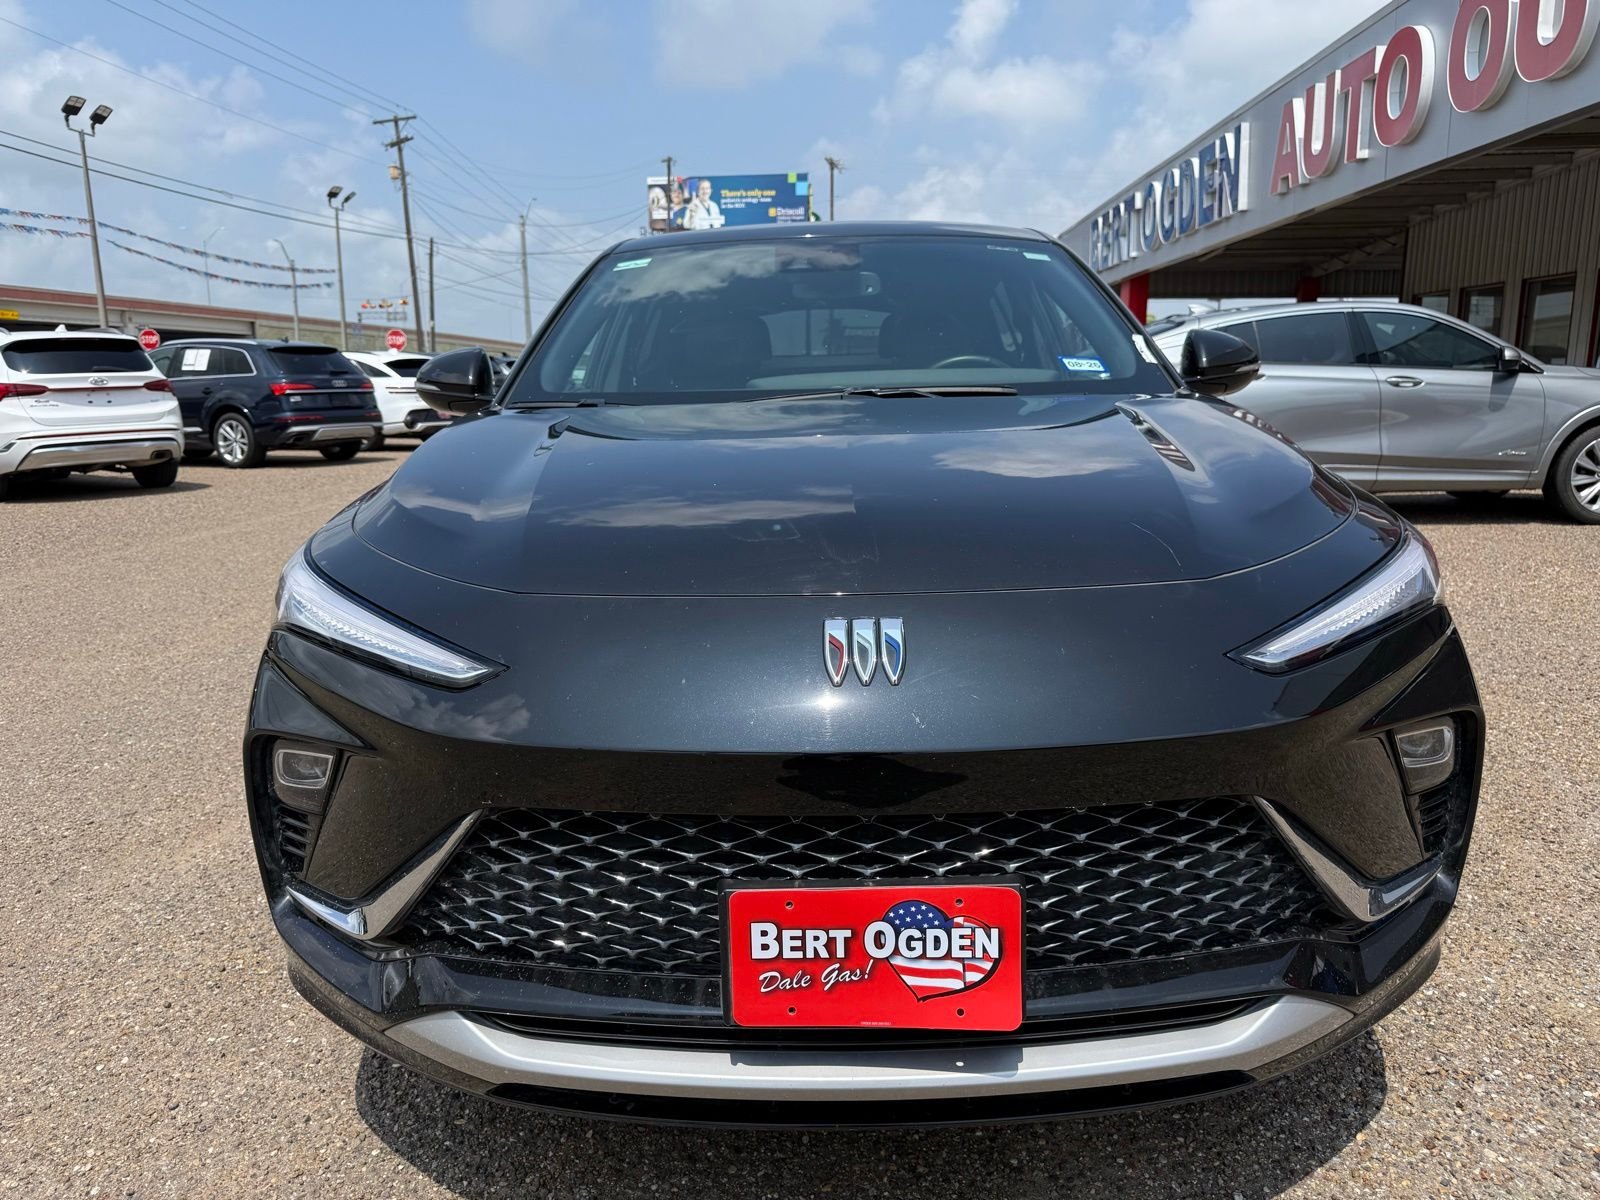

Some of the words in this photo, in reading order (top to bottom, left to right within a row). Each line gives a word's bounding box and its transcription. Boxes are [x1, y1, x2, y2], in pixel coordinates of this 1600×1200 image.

[1090, 191, 1142, 272] BERT
[1140, 122, 1250, 252] OGDEN
[1270, 25, 1434, 195] AUTO
[1447, 0, 1600, 113] OU
[142, 335, 158, 344] STOP
[387, 335, 407, 345] STOP
[750, 921, 852, 960] BERT
[863, 920, 1000, 960] OGDEN
[758, 971, 812, 993] Dale
[821, 959, 874, 991] Gas!
